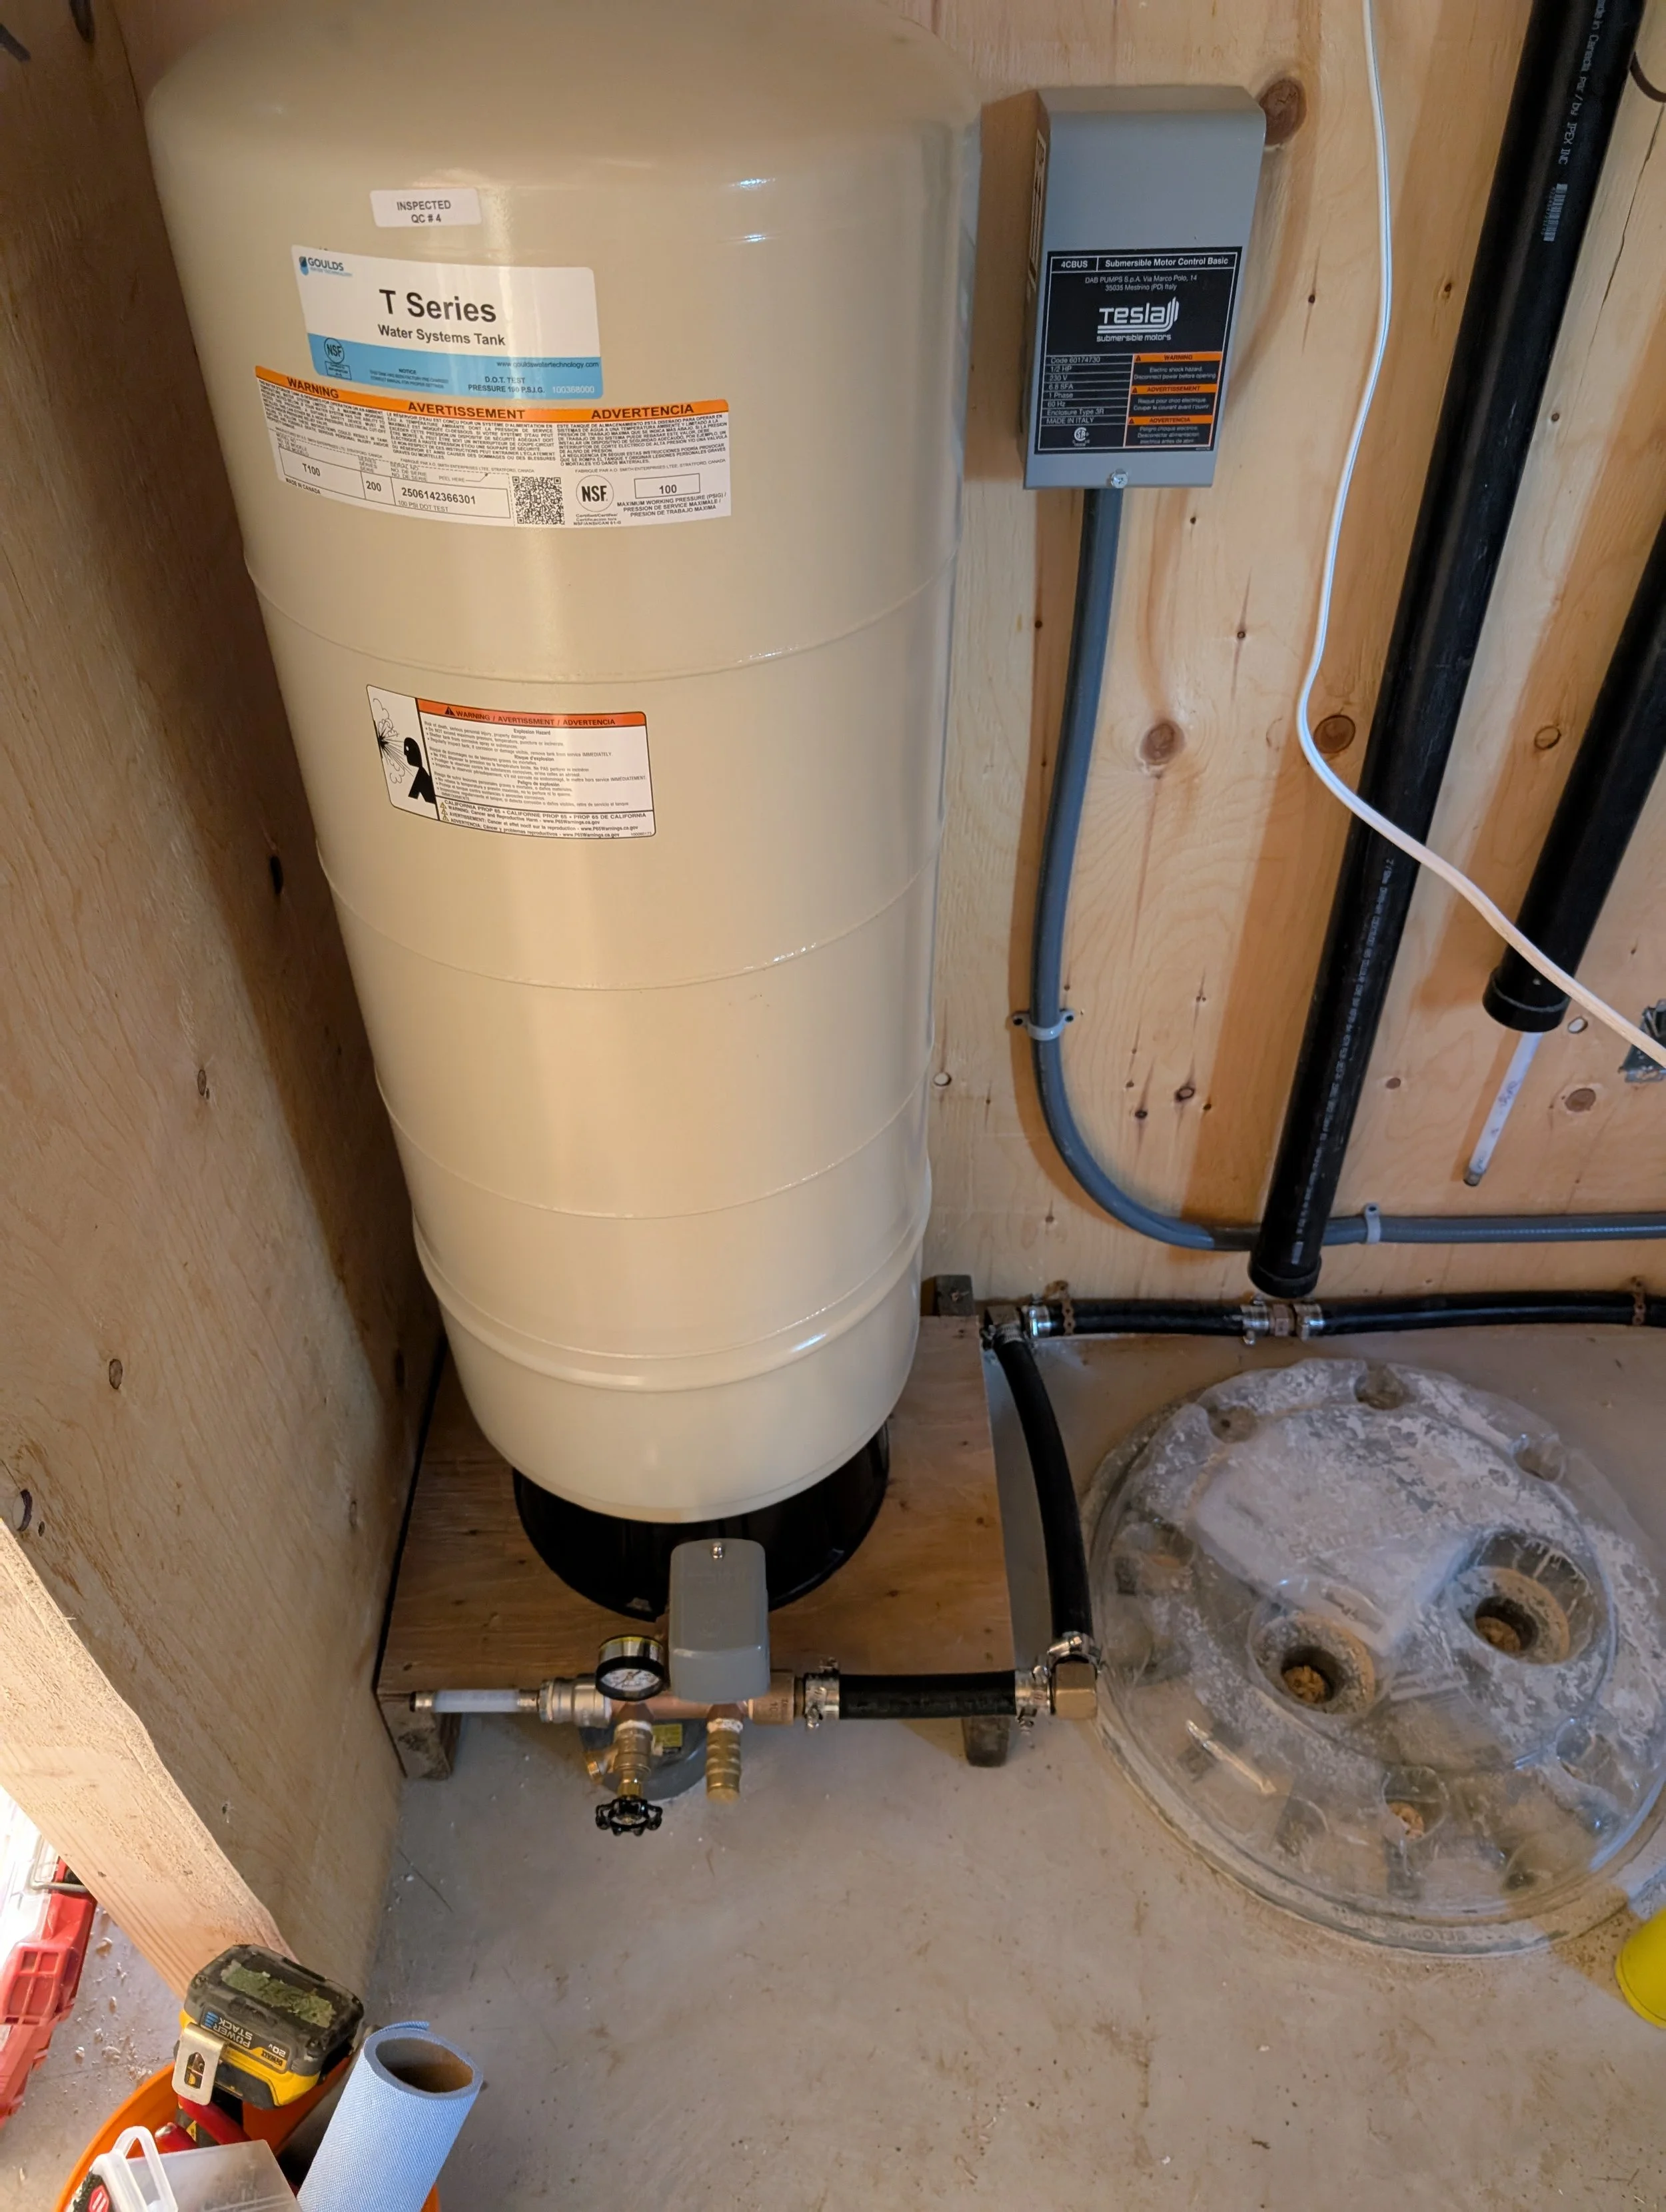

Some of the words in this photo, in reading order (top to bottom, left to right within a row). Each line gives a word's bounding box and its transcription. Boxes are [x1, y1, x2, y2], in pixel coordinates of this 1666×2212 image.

[1564, 123, 1577, 145] IPEX
[397, 200, 451, 211] INSPECTED
[411, 215, 425, 223] QC
[308, 257, 345, 271] GOULDS
[379, 289, 396, 314] T
[407, 292, 496, 322] Series
[378, 324, 413, 340] Water
[416, 328, 470, 345] Systems
[473, 333, 506, 346] Tank
[327, 344, 342, 357] NSF
[287, 377, 339, 398] WARNING
[409, 402, 525, 419] AVERTISSEMENT
[592, 404, 694, 420] ADVERTENCIA
[303, 463, 321, 476] T100
[285, 478, 297, 486] MADE
[303, 484, 321, 494] CANADA
[366, 481, 381, 492] 200
[582, 485, 607, 502] NSF
[659, 484, 677, 494] 100
[402, 487, 476, 504] 2506142366301
[456, 710, 490, 721] WARNING
[498, 716, 554, 725] AVERTISSMENT
[444, 800, 476, 810] CALIFORNIA
[213, 2023, 251, 2048] POWER
[219, 2017, 253, 2040] STACK
